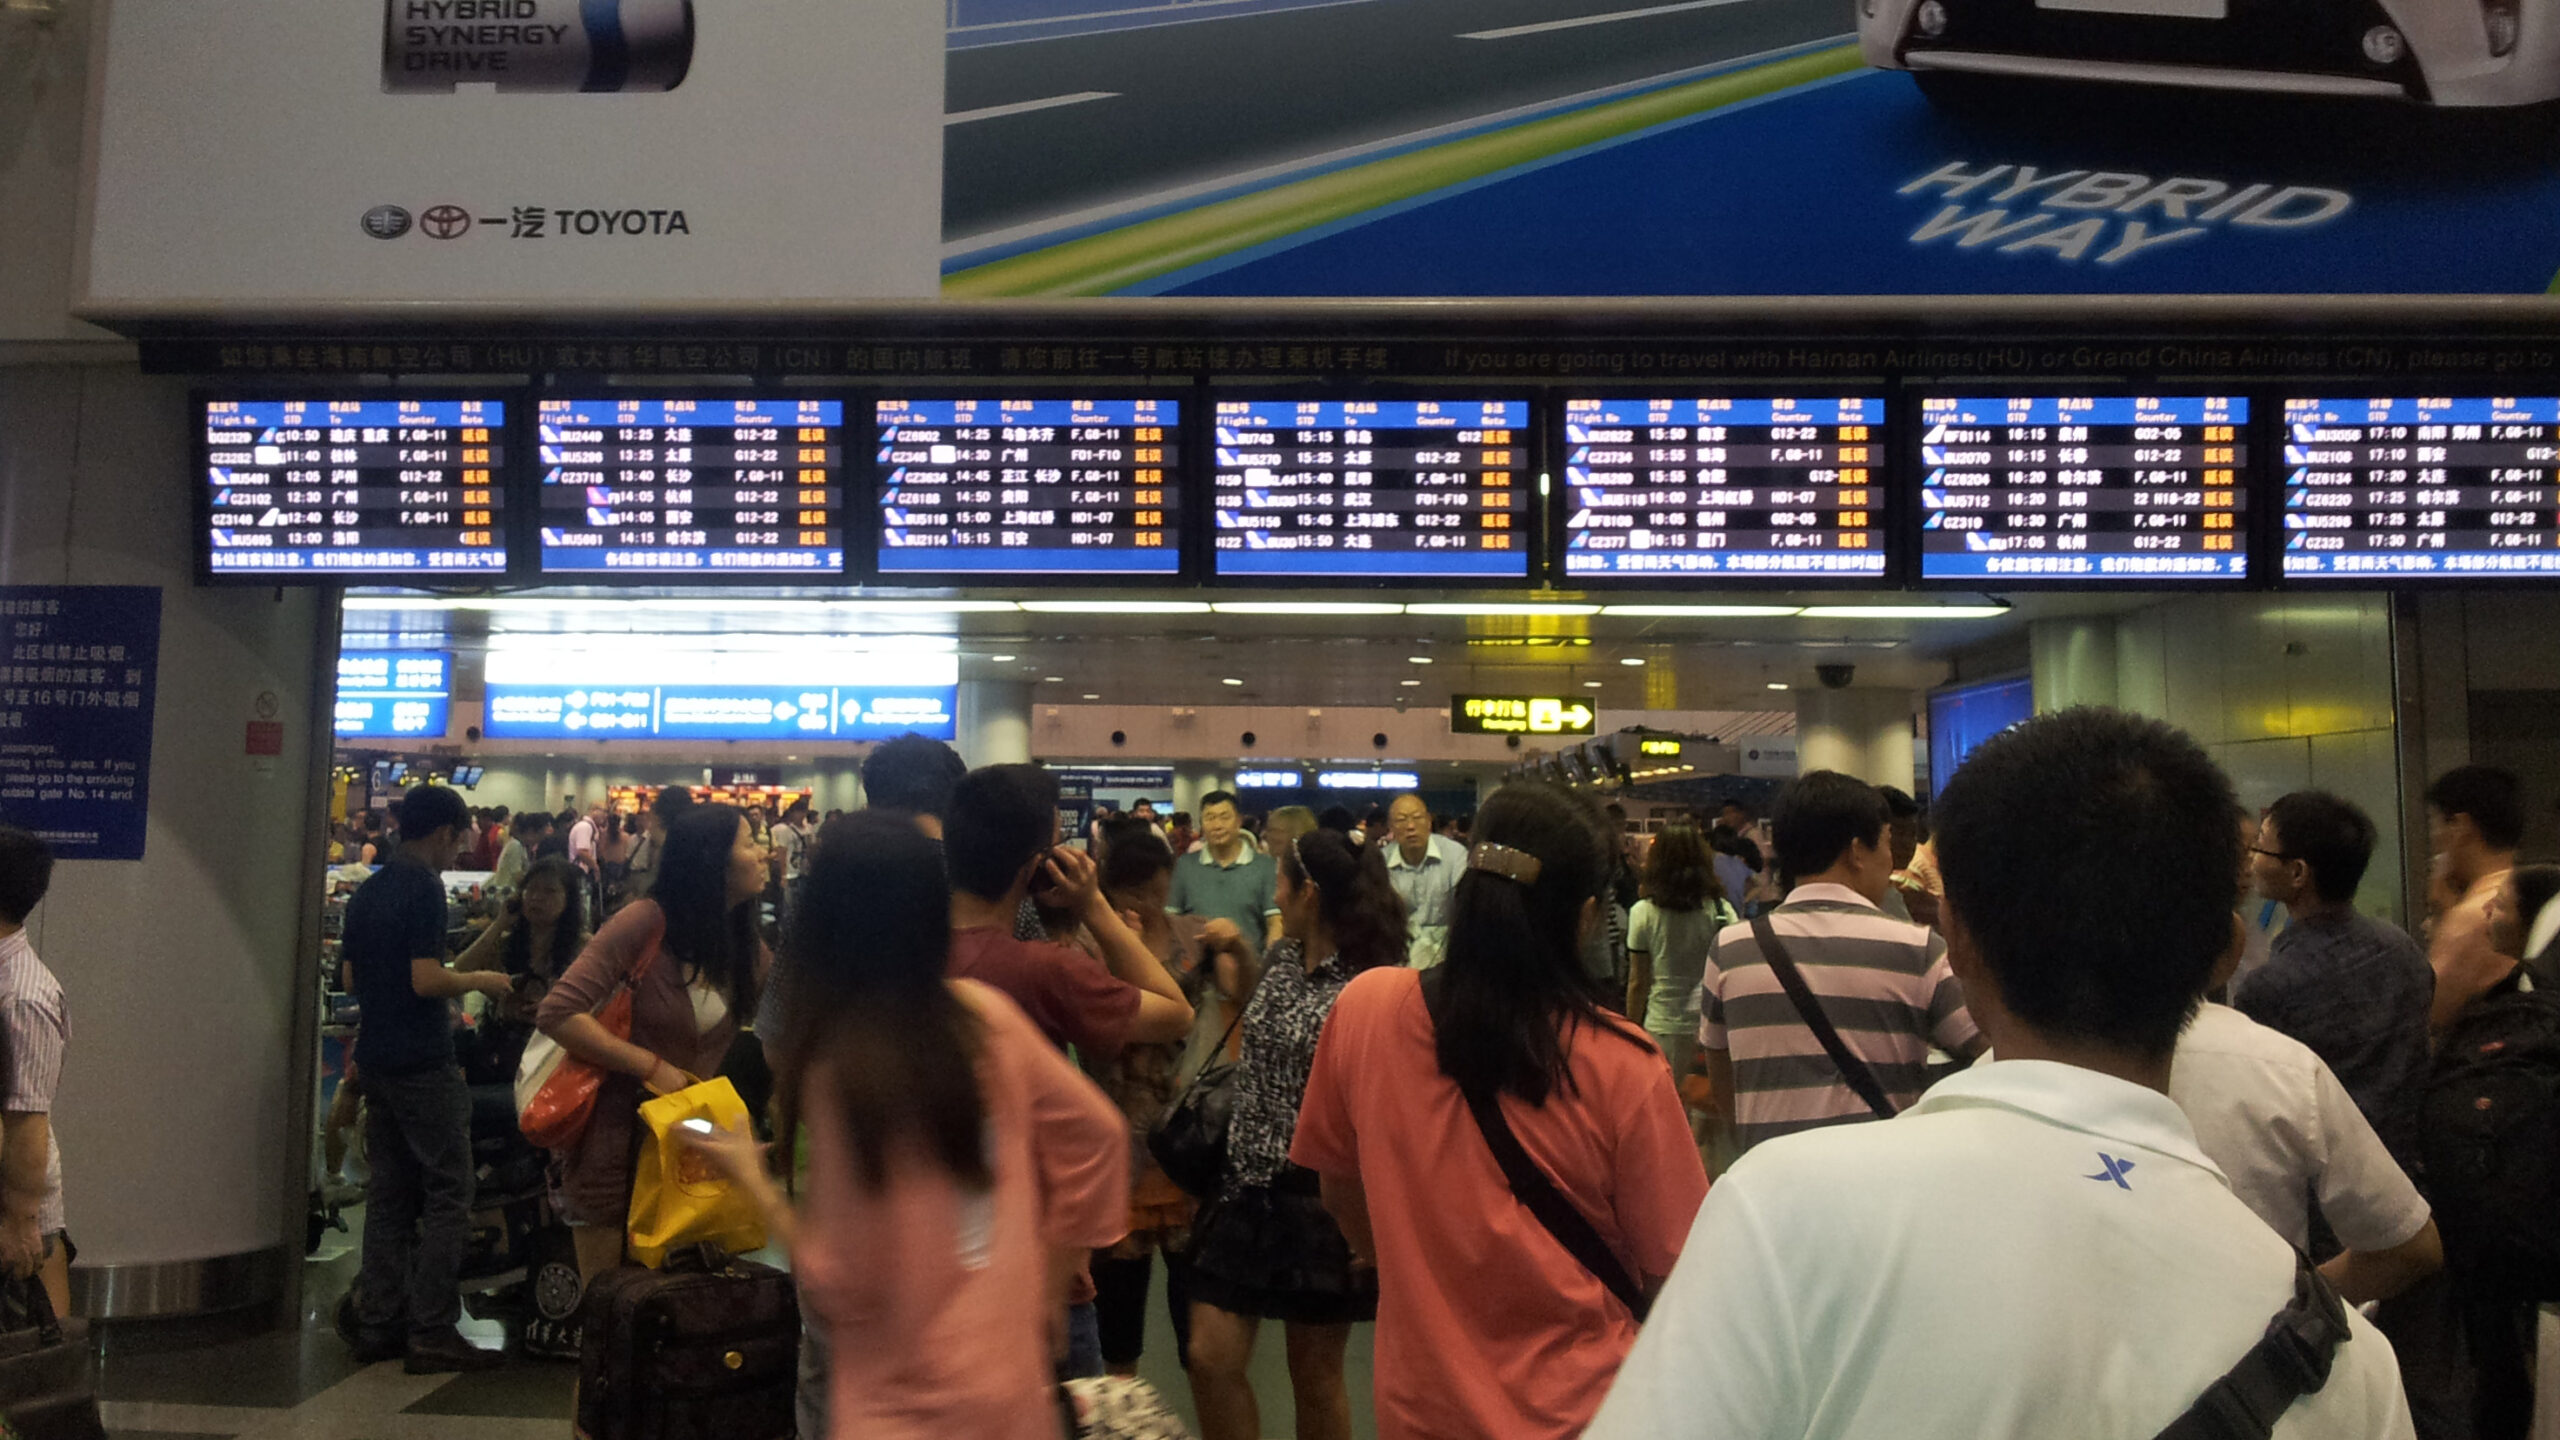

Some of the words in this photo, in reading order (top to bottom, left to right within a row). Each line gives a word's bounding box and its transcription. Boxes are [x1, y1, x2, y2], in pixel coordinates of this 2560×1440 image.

[406, 0, 536, 19] HYBRID
[406, 25, 568, 45] SYNERGY
[405, 51, 508, 72] DRIVE
[1897, 161, 2353, 228] HYBRID
[479, 206, 546, 240] 一汽
[555, 209, 690, 237] TOYOTA
[1909, 205, 2209, 263] WAY
[1464, 353, 1507, 373] you
[1514, 354, 1552, 369] are
[1557, 351, 1625, 373] going
[1632, 351, 1654, 368] to
[1659, 350, 1725, 368] travel
[1732, 350, 1781, 368] with
[1789, 349, 1877, 368] Hainan
[2040, 352, 2064, 367] or
[2072, 348, 2150, 368] Grand
[2159, 348, 2232, 367] China
[2407, 349, 2487, 372] please
[2494, 352, 2525, 372] go
[92, 789, 105, 799] 14
